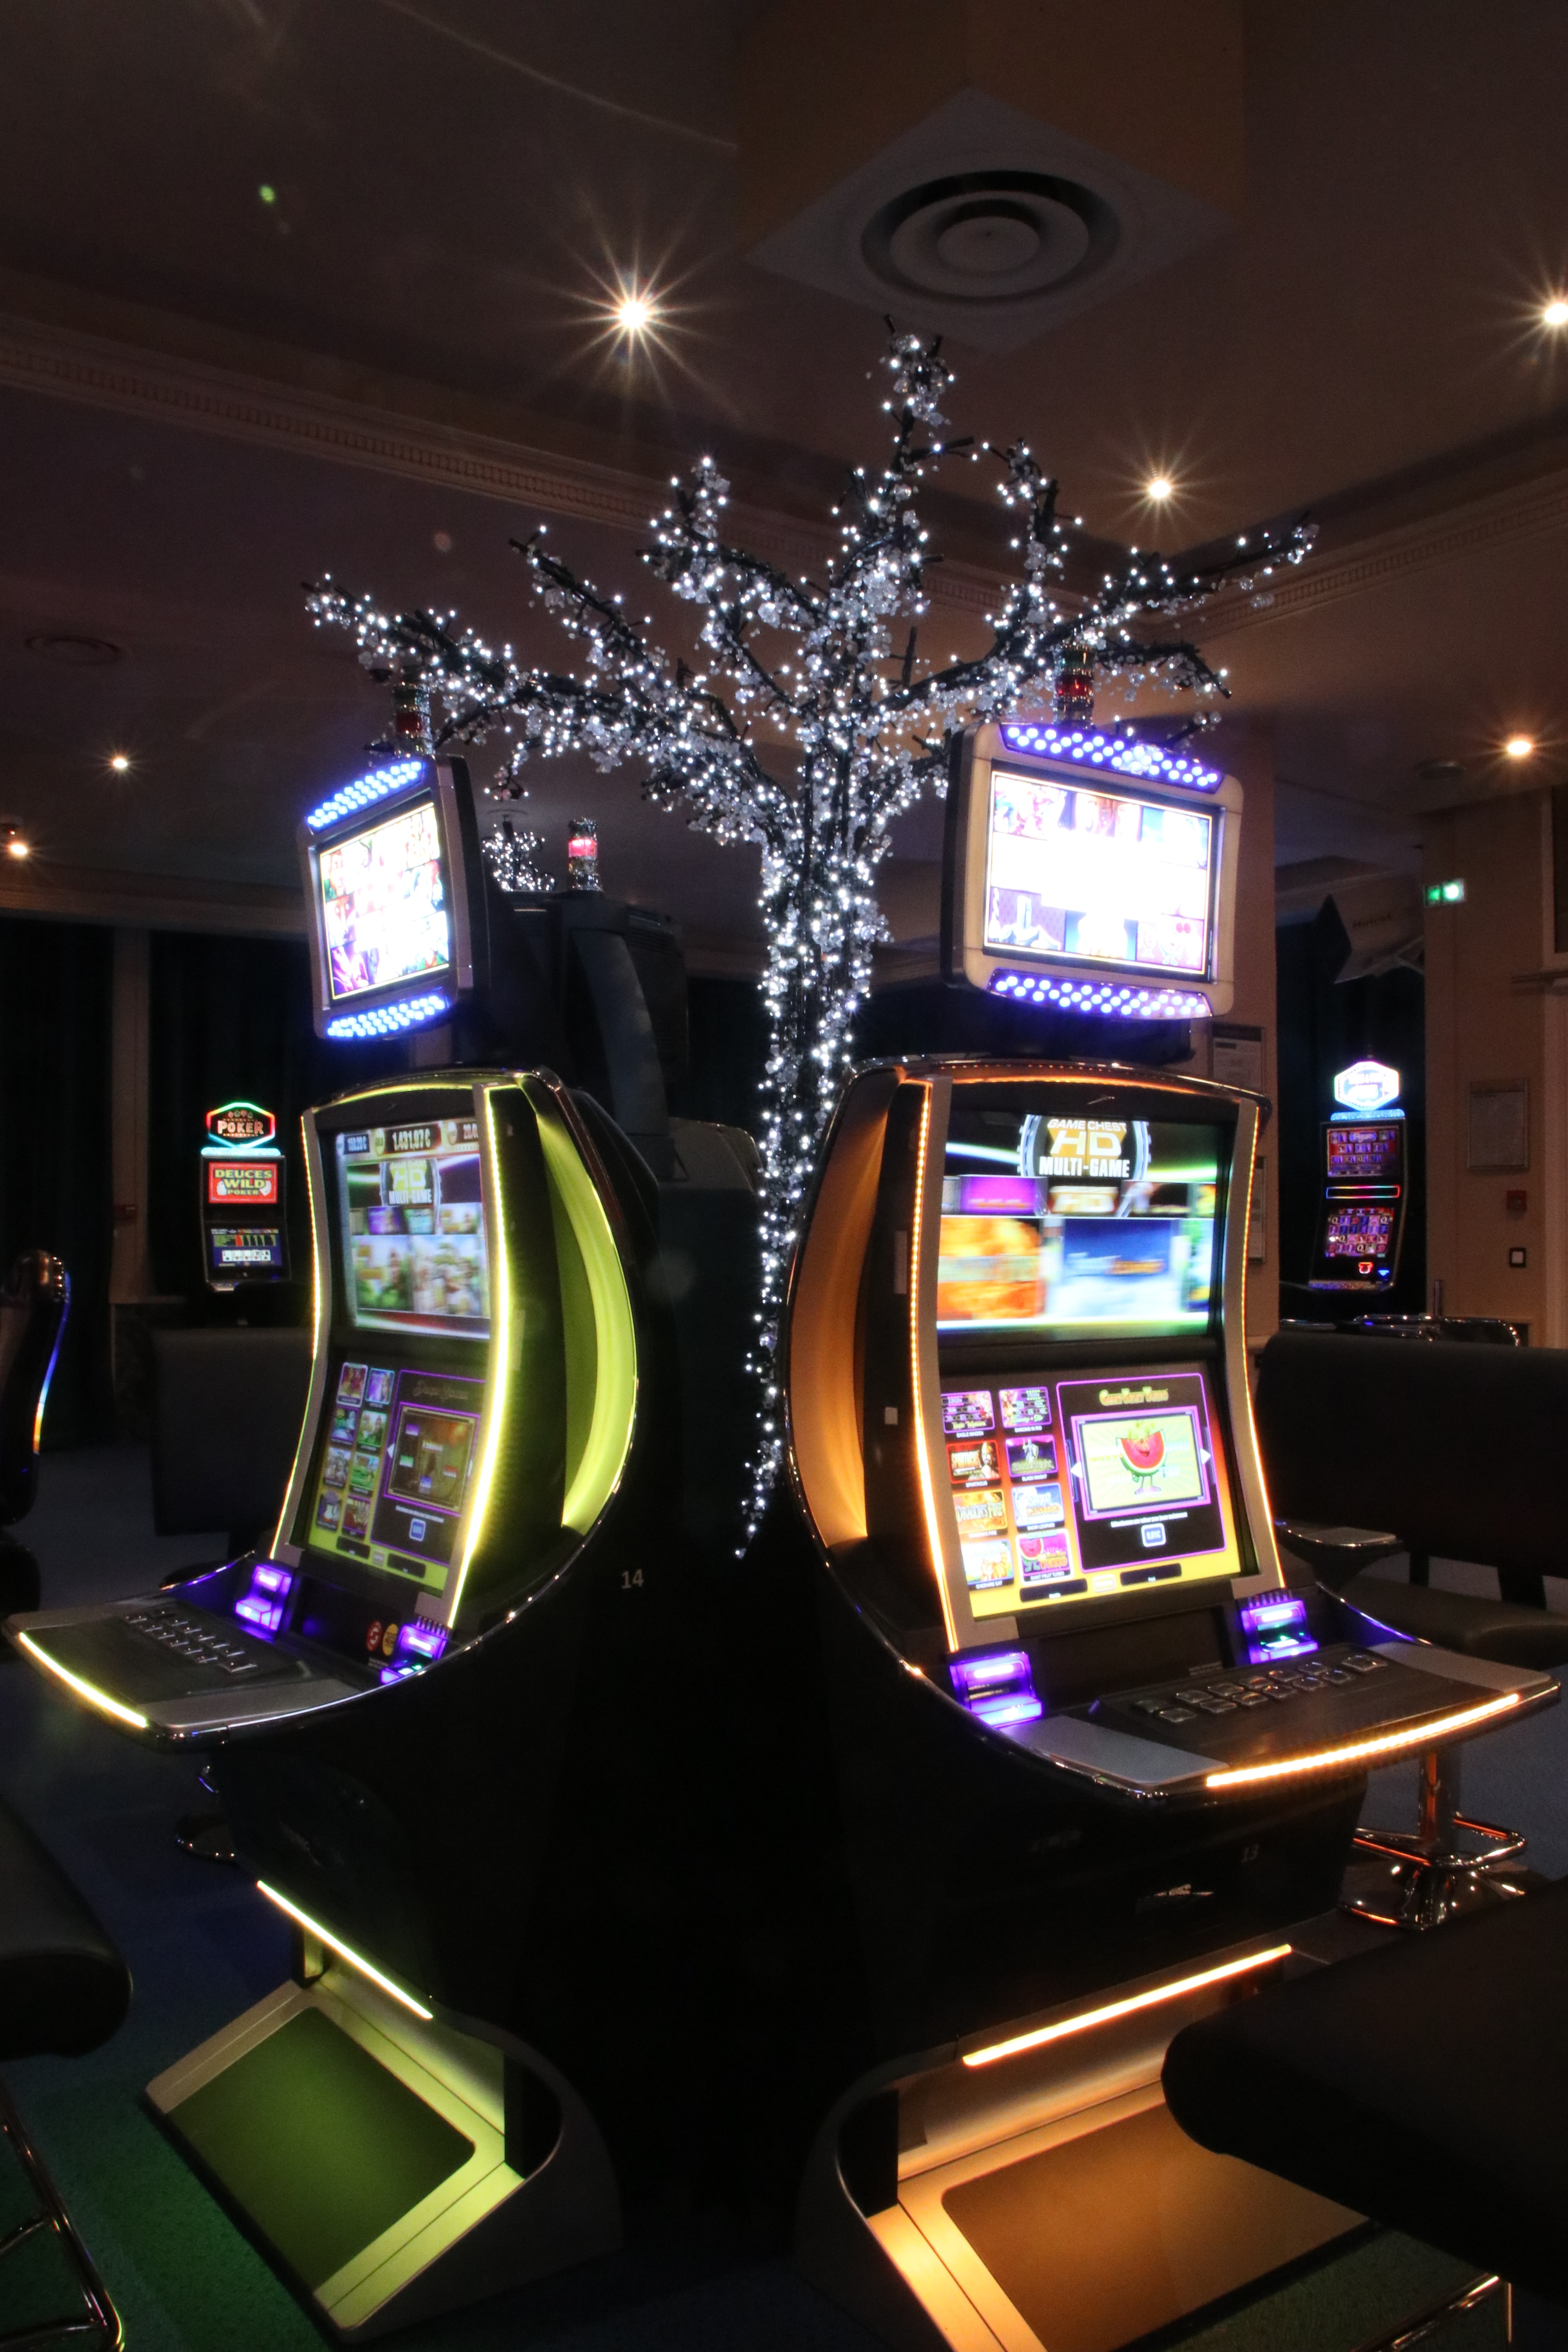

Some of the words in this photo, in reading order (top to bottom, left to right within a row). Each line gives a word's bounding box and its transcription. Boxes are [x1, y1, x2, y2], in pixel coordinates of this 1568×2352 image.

[217, 1120, 264, 1134] POKER
[1047, 1118, 1086, 1129] GAME
[1087, 1121, 1127, 1132] CHEST
[1050, 1130, 1122, 1156] HD
[215, 1169, 273, 1179] DEUCES
[1039, 1156, 1130, 1178] MULTI-GAME
[223, 1178, 266, 1189] WILD
[392, 1169, 426, 1188] HD
[388, 1189, 432, 1204] MULTI-GAME
[622, 1569, 644, 1589] 14
